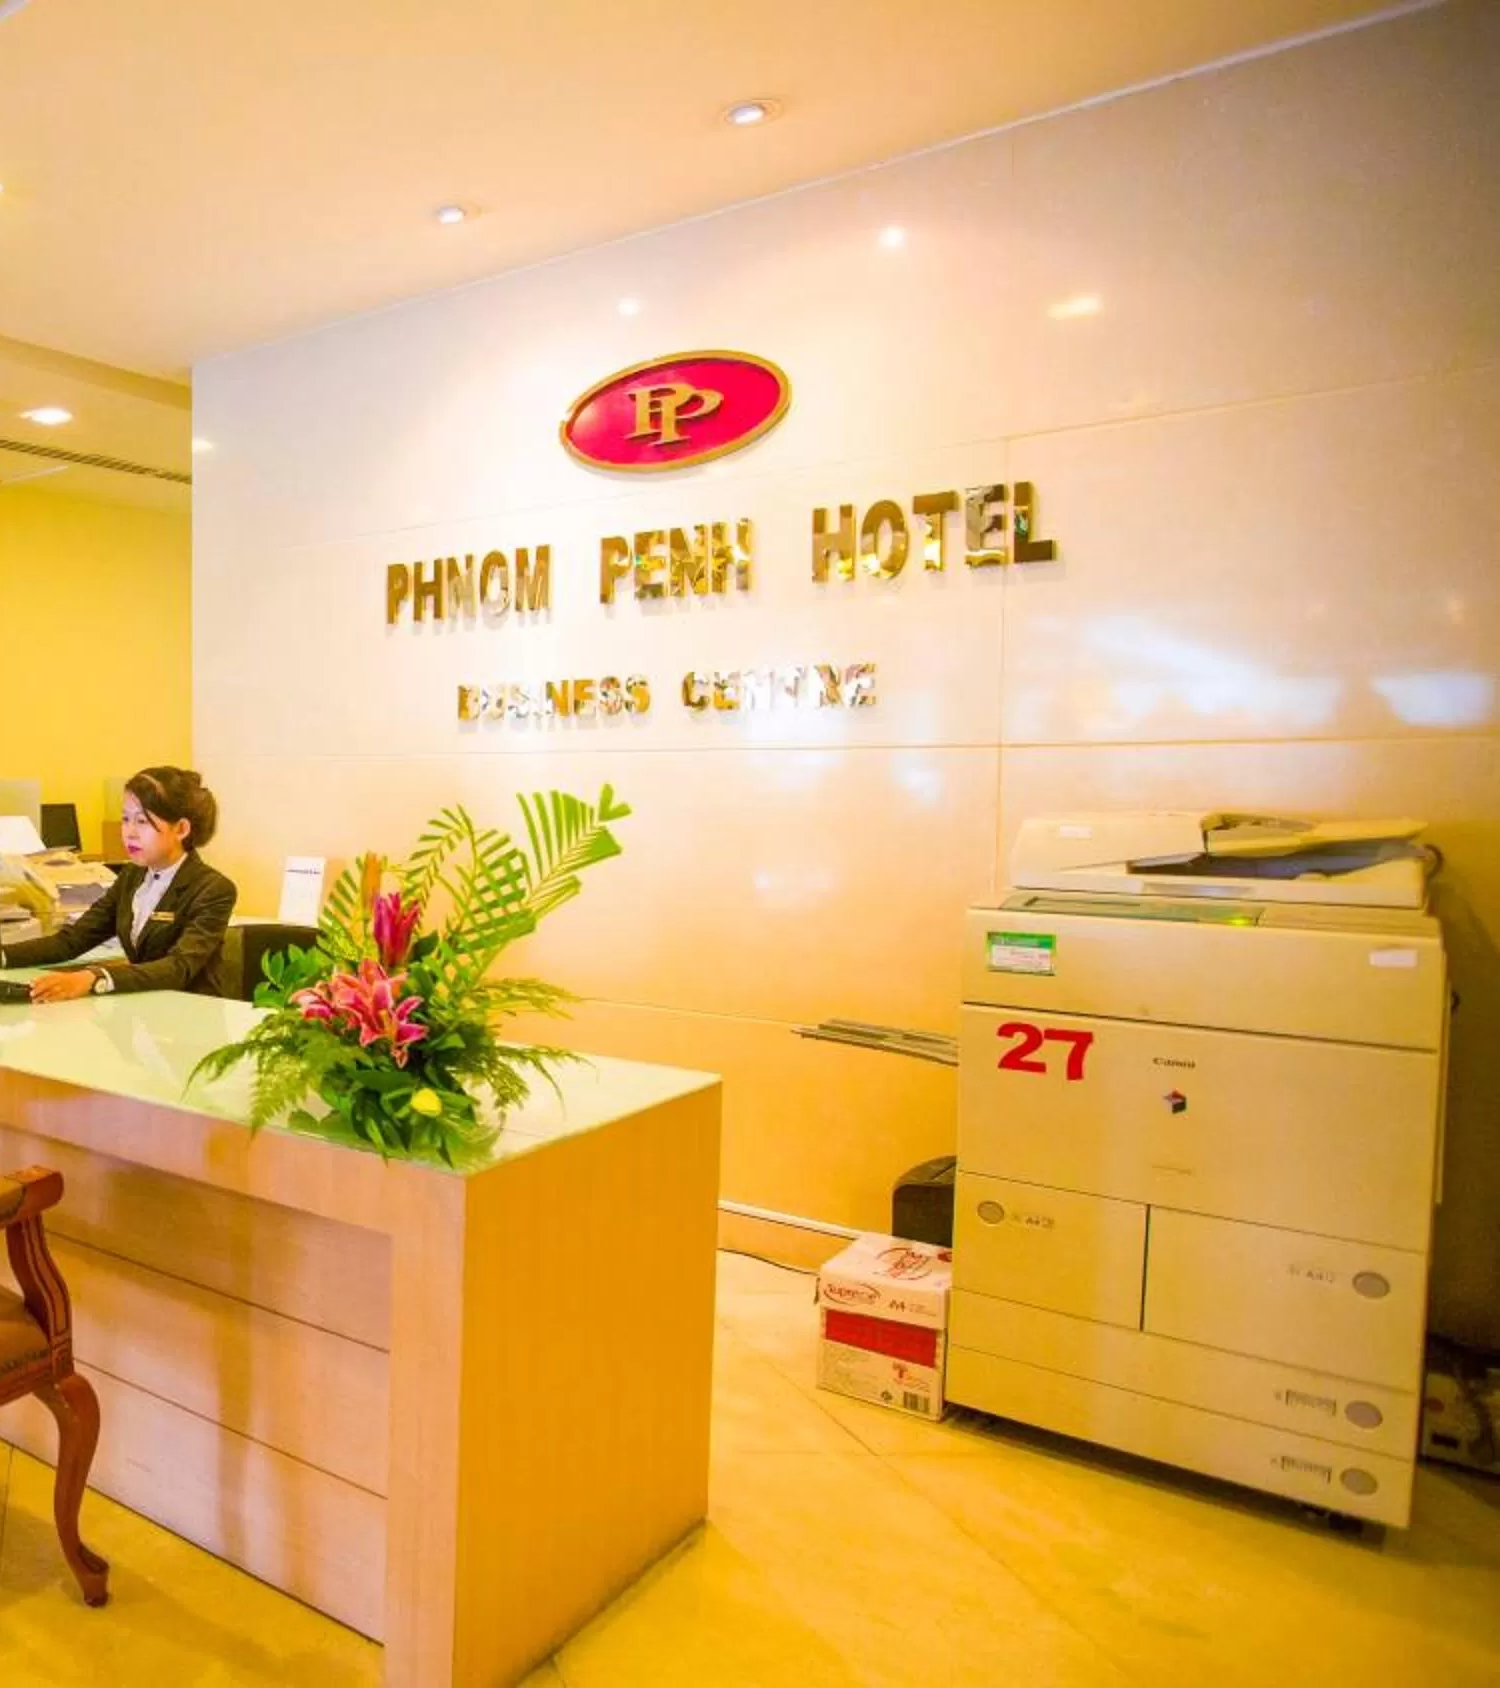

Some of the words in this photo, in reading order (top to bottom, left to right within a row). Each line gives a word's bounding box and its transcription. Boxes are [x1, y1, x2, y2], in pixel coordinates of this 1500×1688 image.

[387, 544, 552, 625] PHNOM
[600, 517, 751, 604] PENH
[812, 481, 1058, 585] HOTEL
[457, 674, 652, 721] BUSINESS
[997, 1022, 1094, 1081] 27
